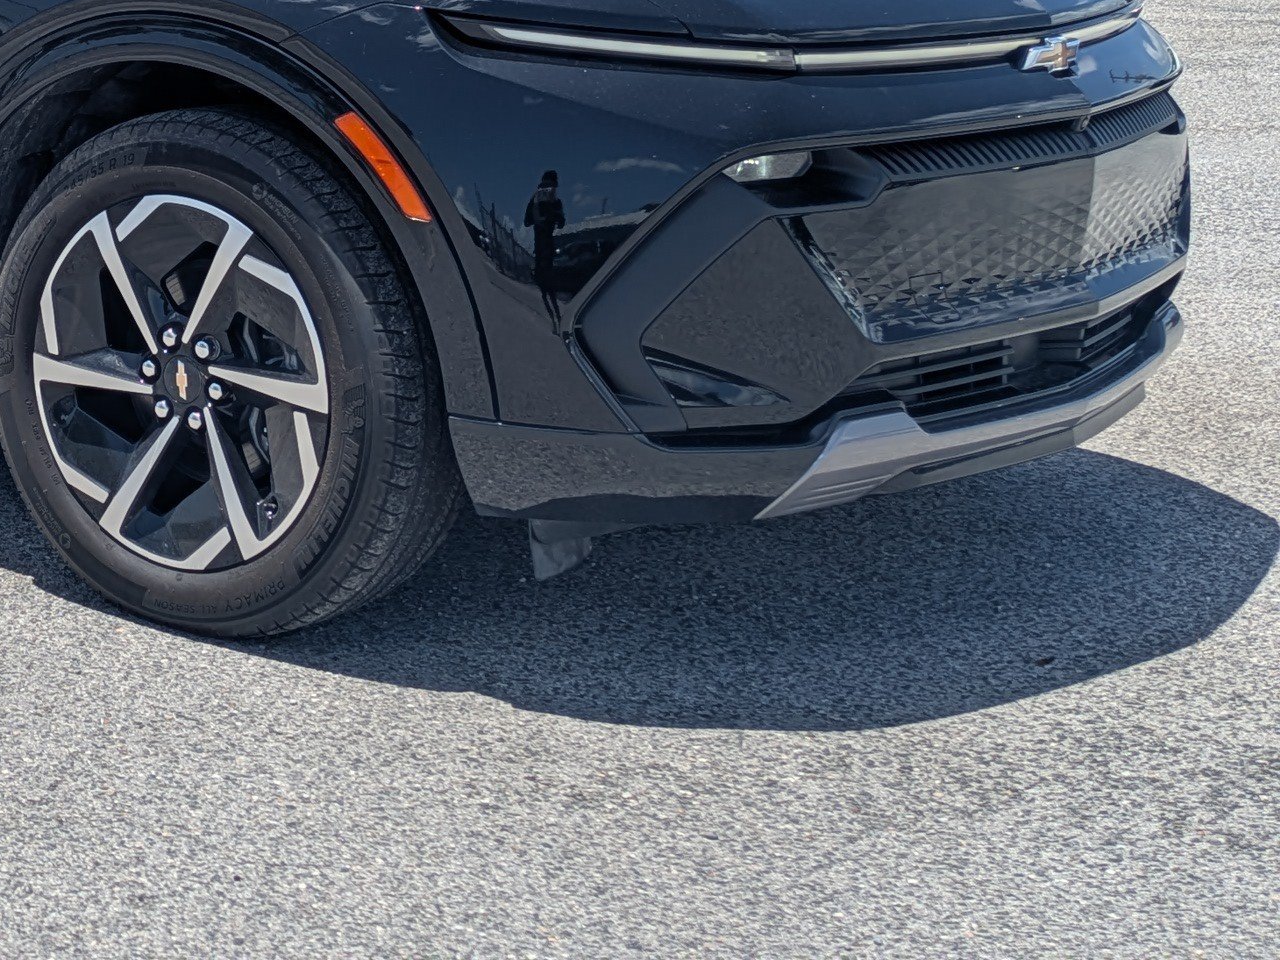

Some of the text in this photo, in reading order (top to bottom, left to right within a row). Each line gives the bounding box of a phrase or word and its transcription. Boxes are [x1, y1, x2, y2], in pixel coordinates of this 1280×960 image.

[109, 158, 117, 170] R
[123, 153, 135, 166] 19
[292, 436, 360, 570] MICHELIN
[153, 598, 195, 614] SEASON
[225, 577, 286, 613] PRIMACY
